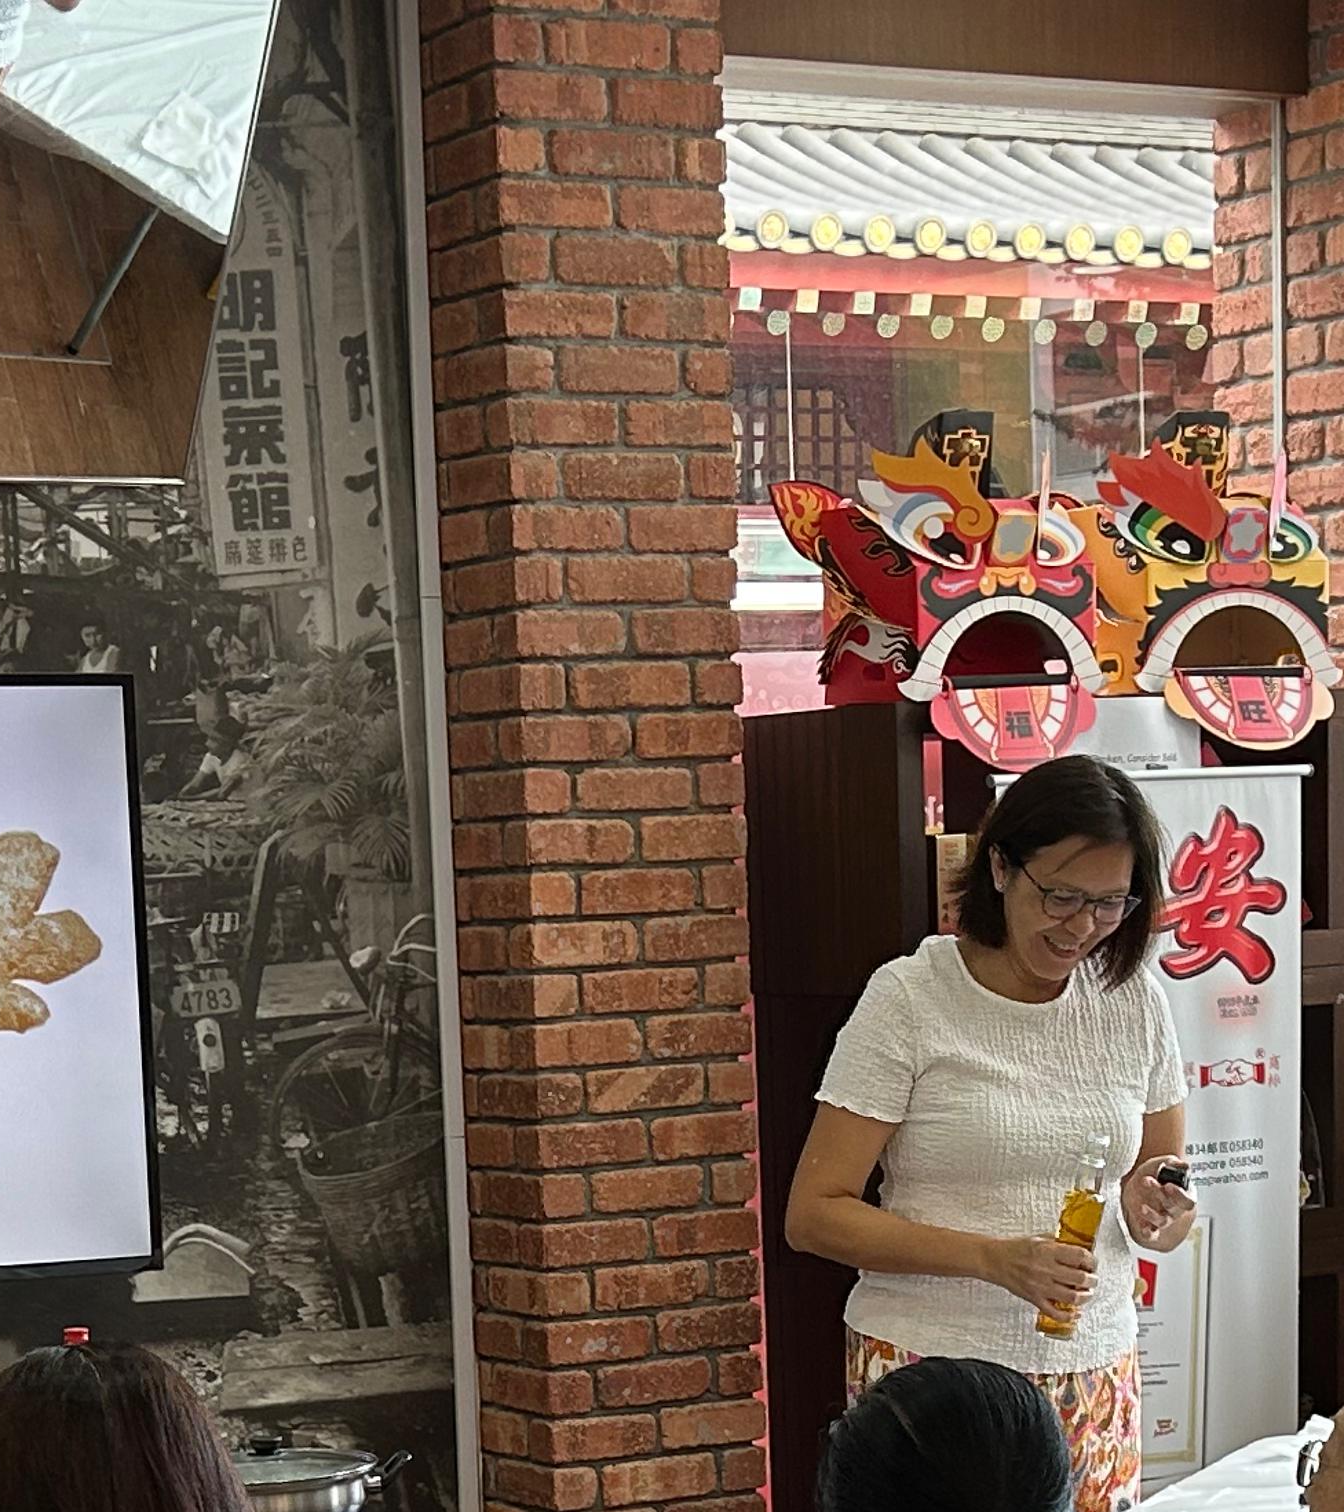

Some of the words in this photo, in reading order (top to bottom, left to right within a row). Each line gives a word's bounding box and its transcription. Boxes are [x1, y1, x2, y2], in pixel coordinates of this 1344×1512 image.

[1006, 710, 1033, 739] 福
[1241, 700, 1270, 723] 旺
[1157, 805, 1287, 984] 安
